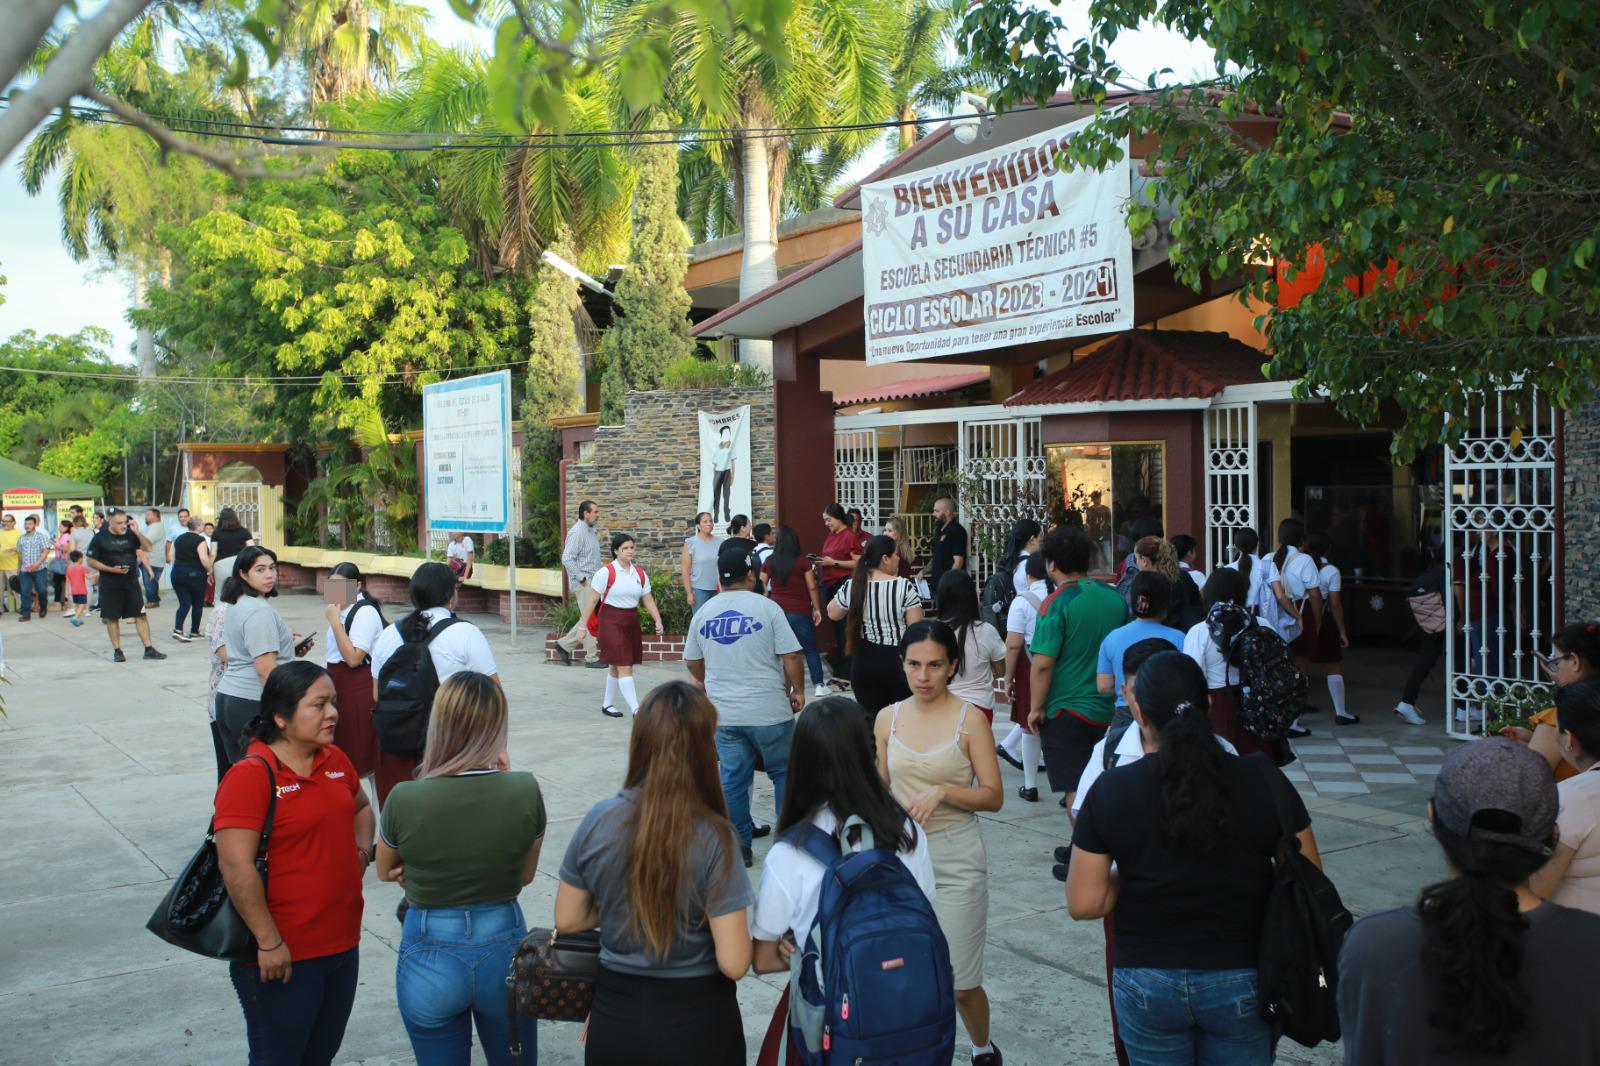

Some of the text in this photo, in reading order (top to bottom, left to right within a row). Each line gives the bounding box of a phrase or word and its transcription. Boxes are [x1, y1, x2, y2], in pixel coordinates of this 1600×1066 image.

[911, 180, 1061, 251] A SU CASA
[880, 222, 1098, 291] ESCUELA SECUNDARIA TÉCNICA #5
[870, 303, 916, 335] CICLO
[919, 290, 994, 328] ESCOLAR
[951, 333, 970, 349] para
[971, 330, 992, 345] tener
[1009, 326, 1027, 341] gran
[705, 616, 754, 640] RICE
